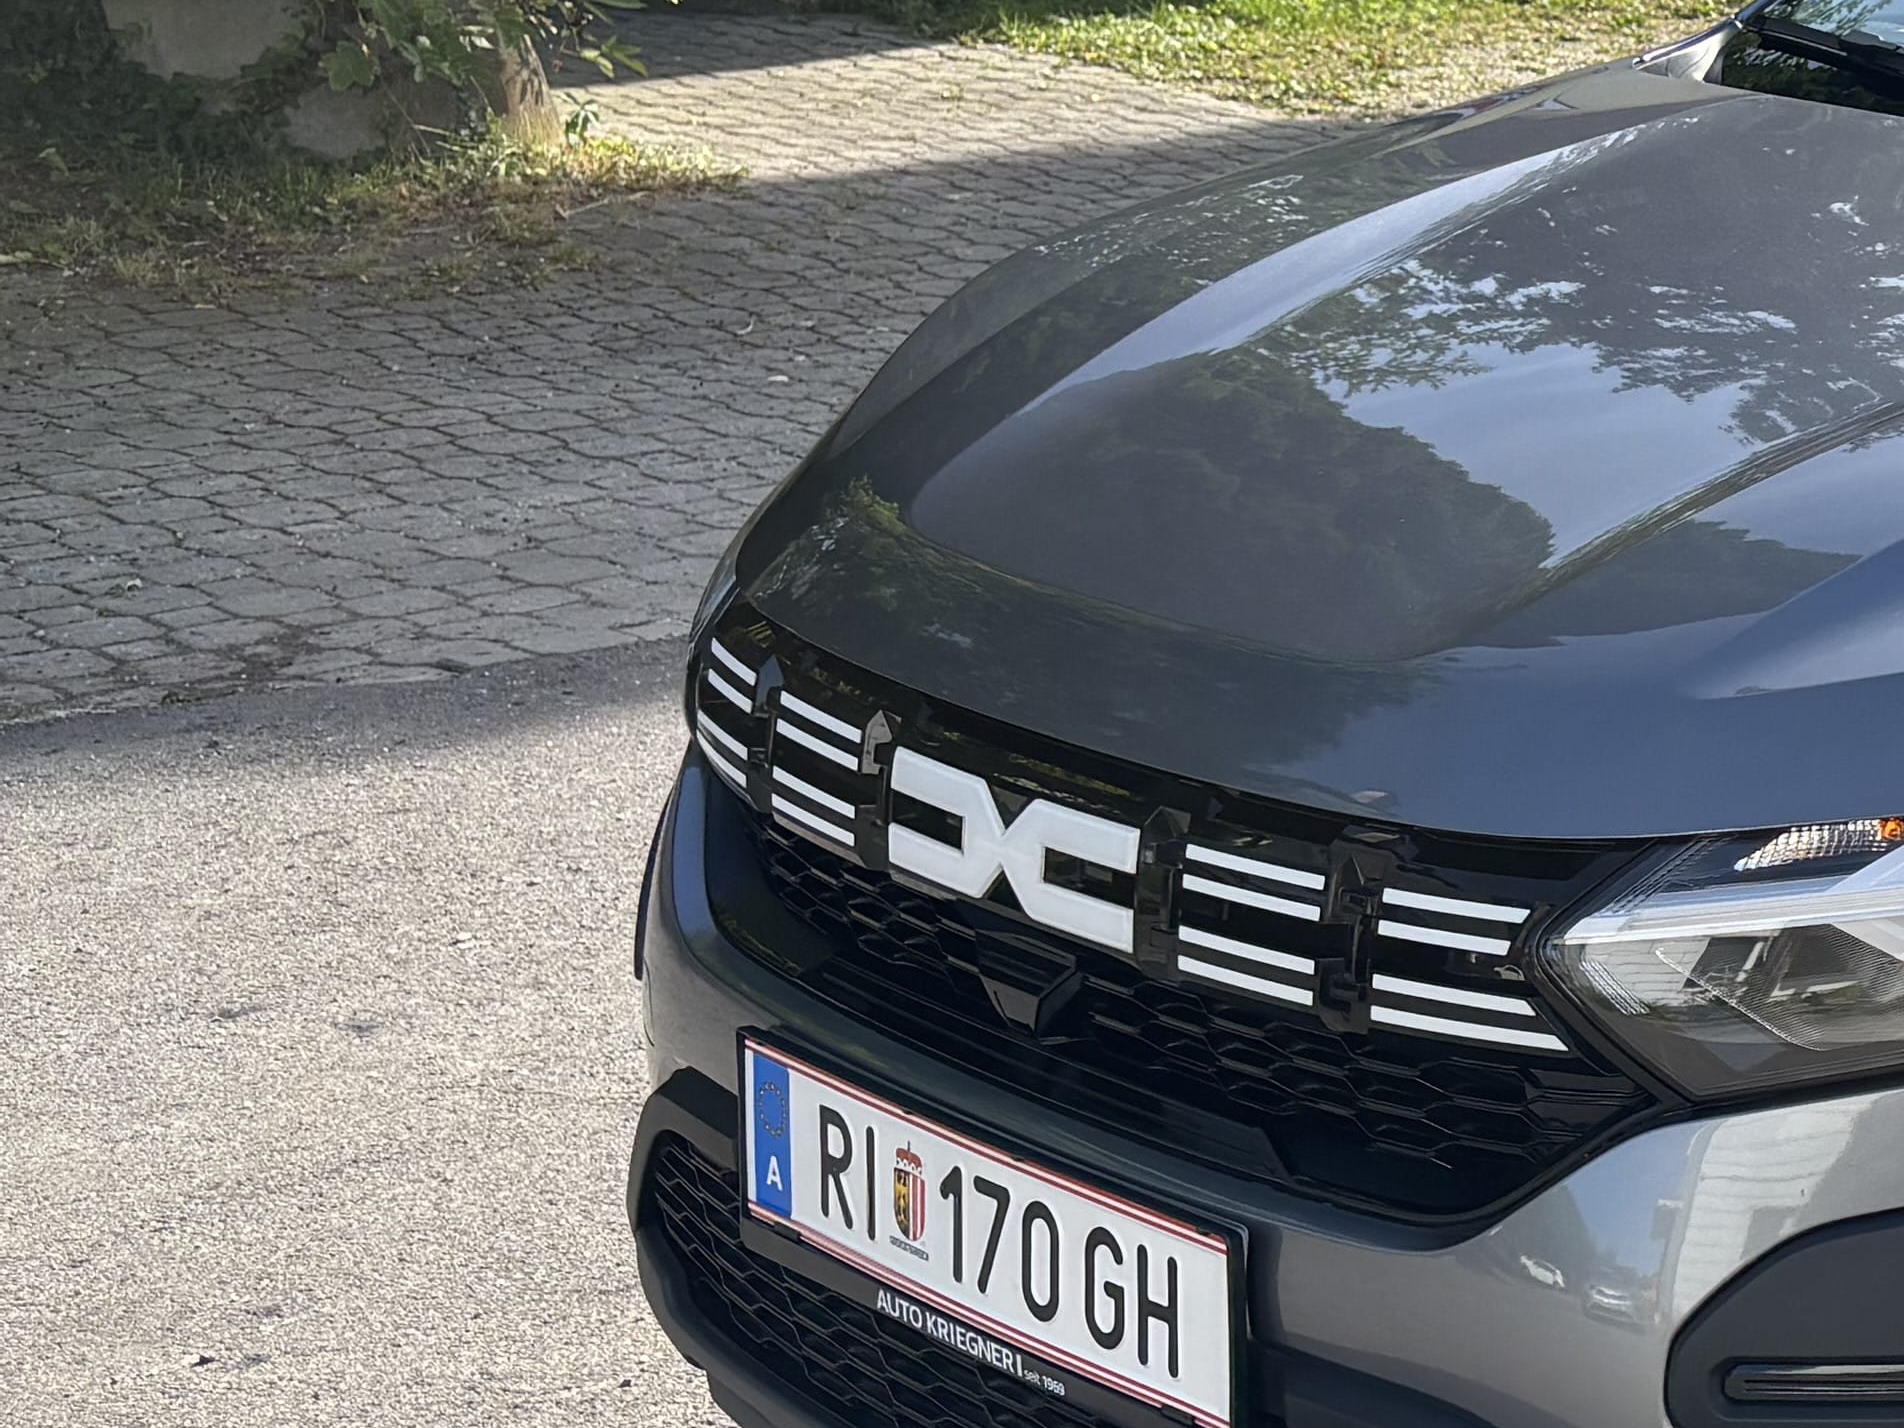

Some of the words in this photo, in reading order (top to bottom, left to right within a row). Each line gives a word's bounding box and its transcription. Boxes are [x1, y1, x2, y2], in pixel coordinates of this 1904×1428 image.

[764, 1155, 785, 1192] A
[818, 1103, 878, 1242] RI
[939, 1165, 1060, 1323] 170
[1083, 1226, 1180, 1380] GH
[876, 1288, 923, 1330] AUTO
[925, 1311, 1015, 1374] KRIEGNER
